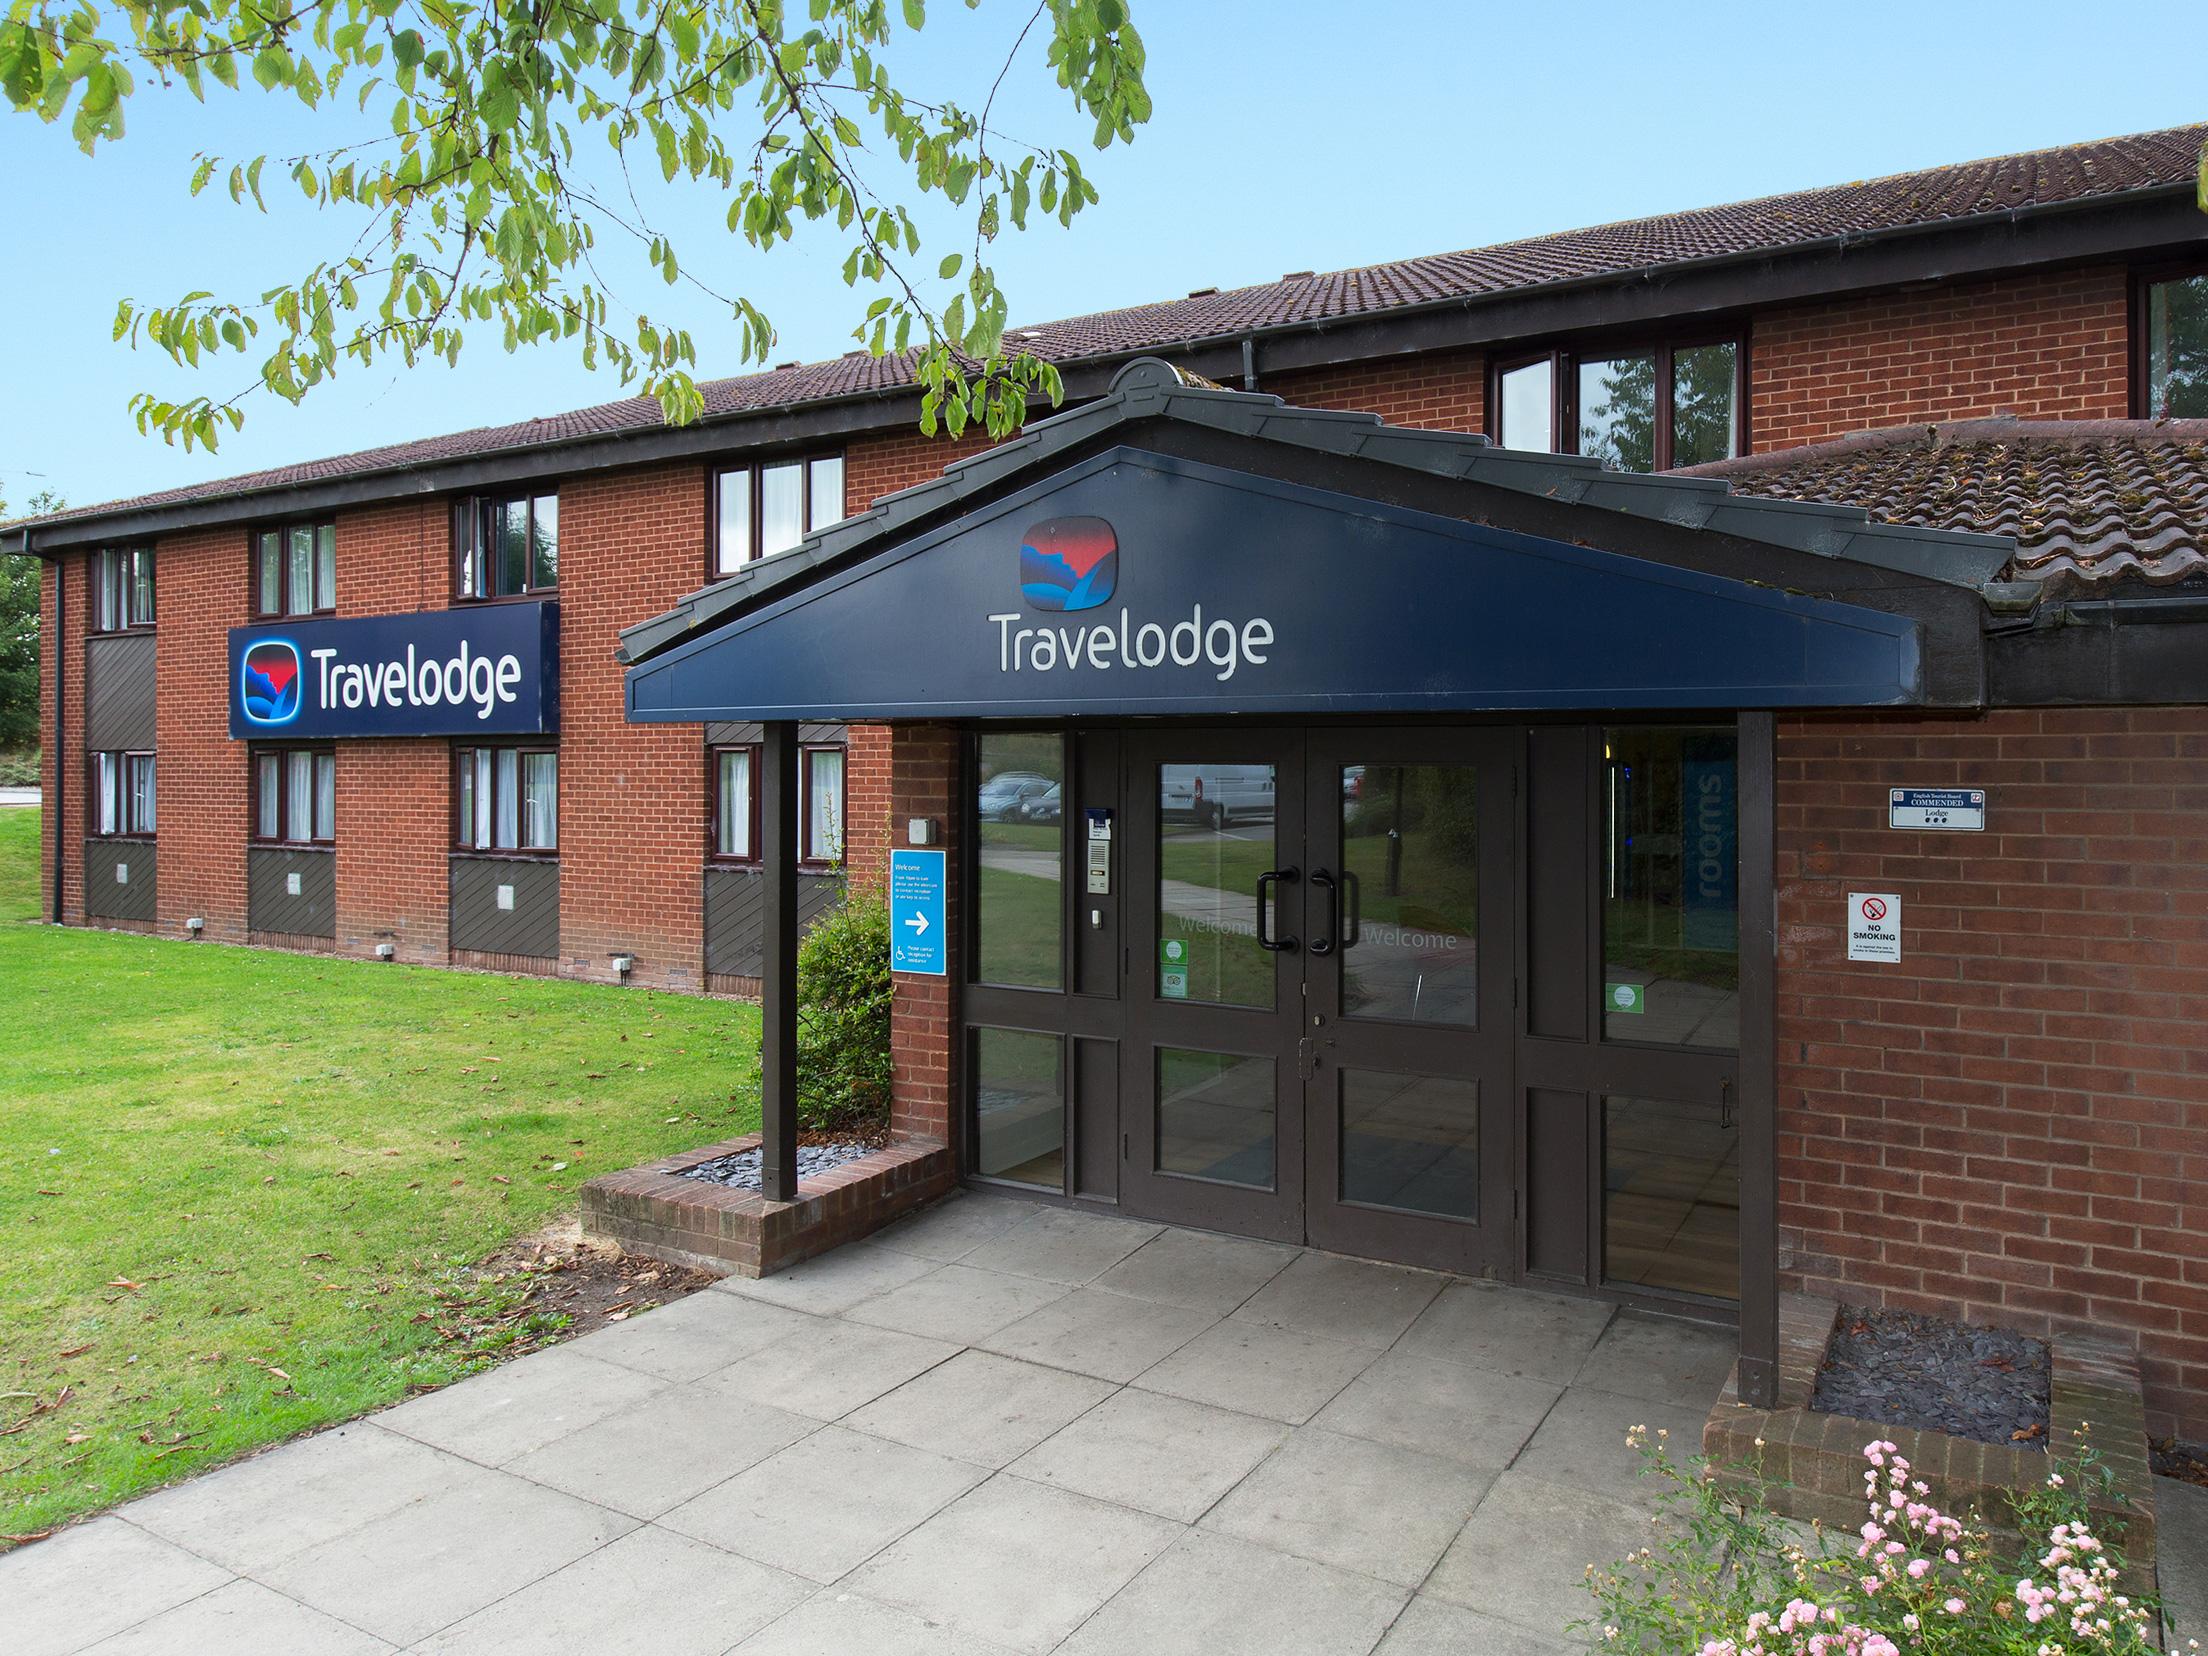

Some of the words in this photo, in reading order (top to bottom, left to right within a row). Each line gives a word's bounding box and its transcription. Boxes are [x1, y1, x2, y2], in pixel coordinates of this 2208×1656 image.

[987, 603, 1274, 681] Travelodge
[311, 640, 521, 719] Travelodge
[1911, 799, 1964, 807] COMMENDED
[1925, 809, 1949, 817] Lodge
[1699, 774, 1723, 898] rooms
[1868, 924, 1881, 932] NO
[1364, 927, 1457, 950] Welcome
[1853, 932, 1896, 941] SMOKING
